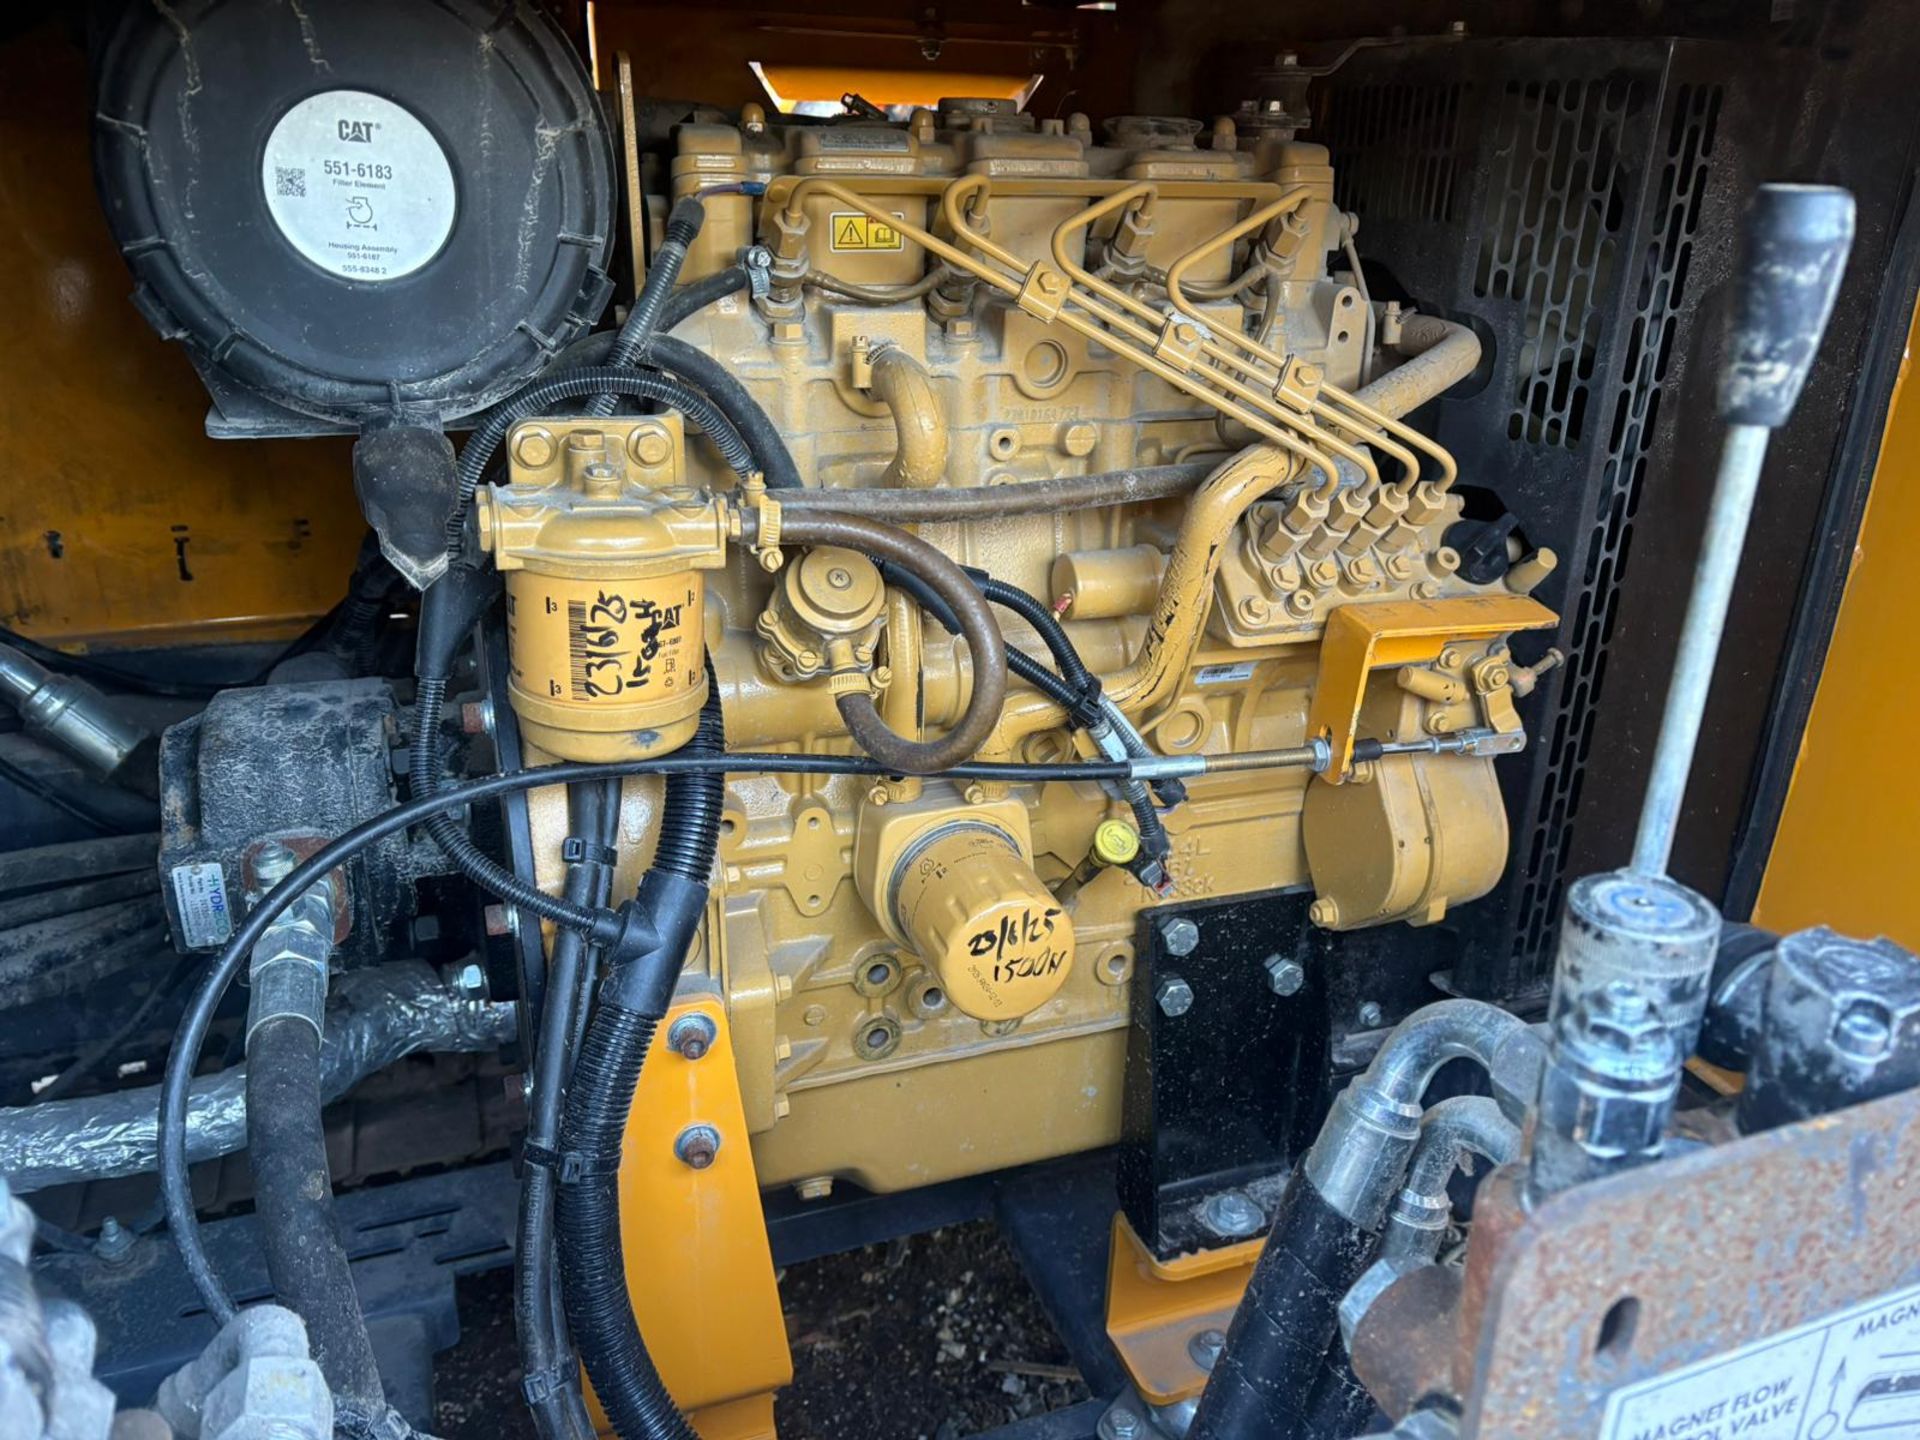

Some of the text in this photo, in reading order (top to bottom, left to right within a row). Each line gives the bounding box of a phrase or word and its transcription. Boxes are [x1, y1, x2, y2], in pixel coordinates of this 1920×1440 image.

[338, 119, 373, 143] CAT
[324, 160, 393, 180] 551-6183
[333, 179, 386, 191] Filter Element
[328, 241, 398, 256] Housing Assembly
[207, 874, 230, 935] HYDRECO
[1633, 1376, 1793, 1440] MAGNET FLOW
[1731, 1395, 1800, 1435] VALVE
